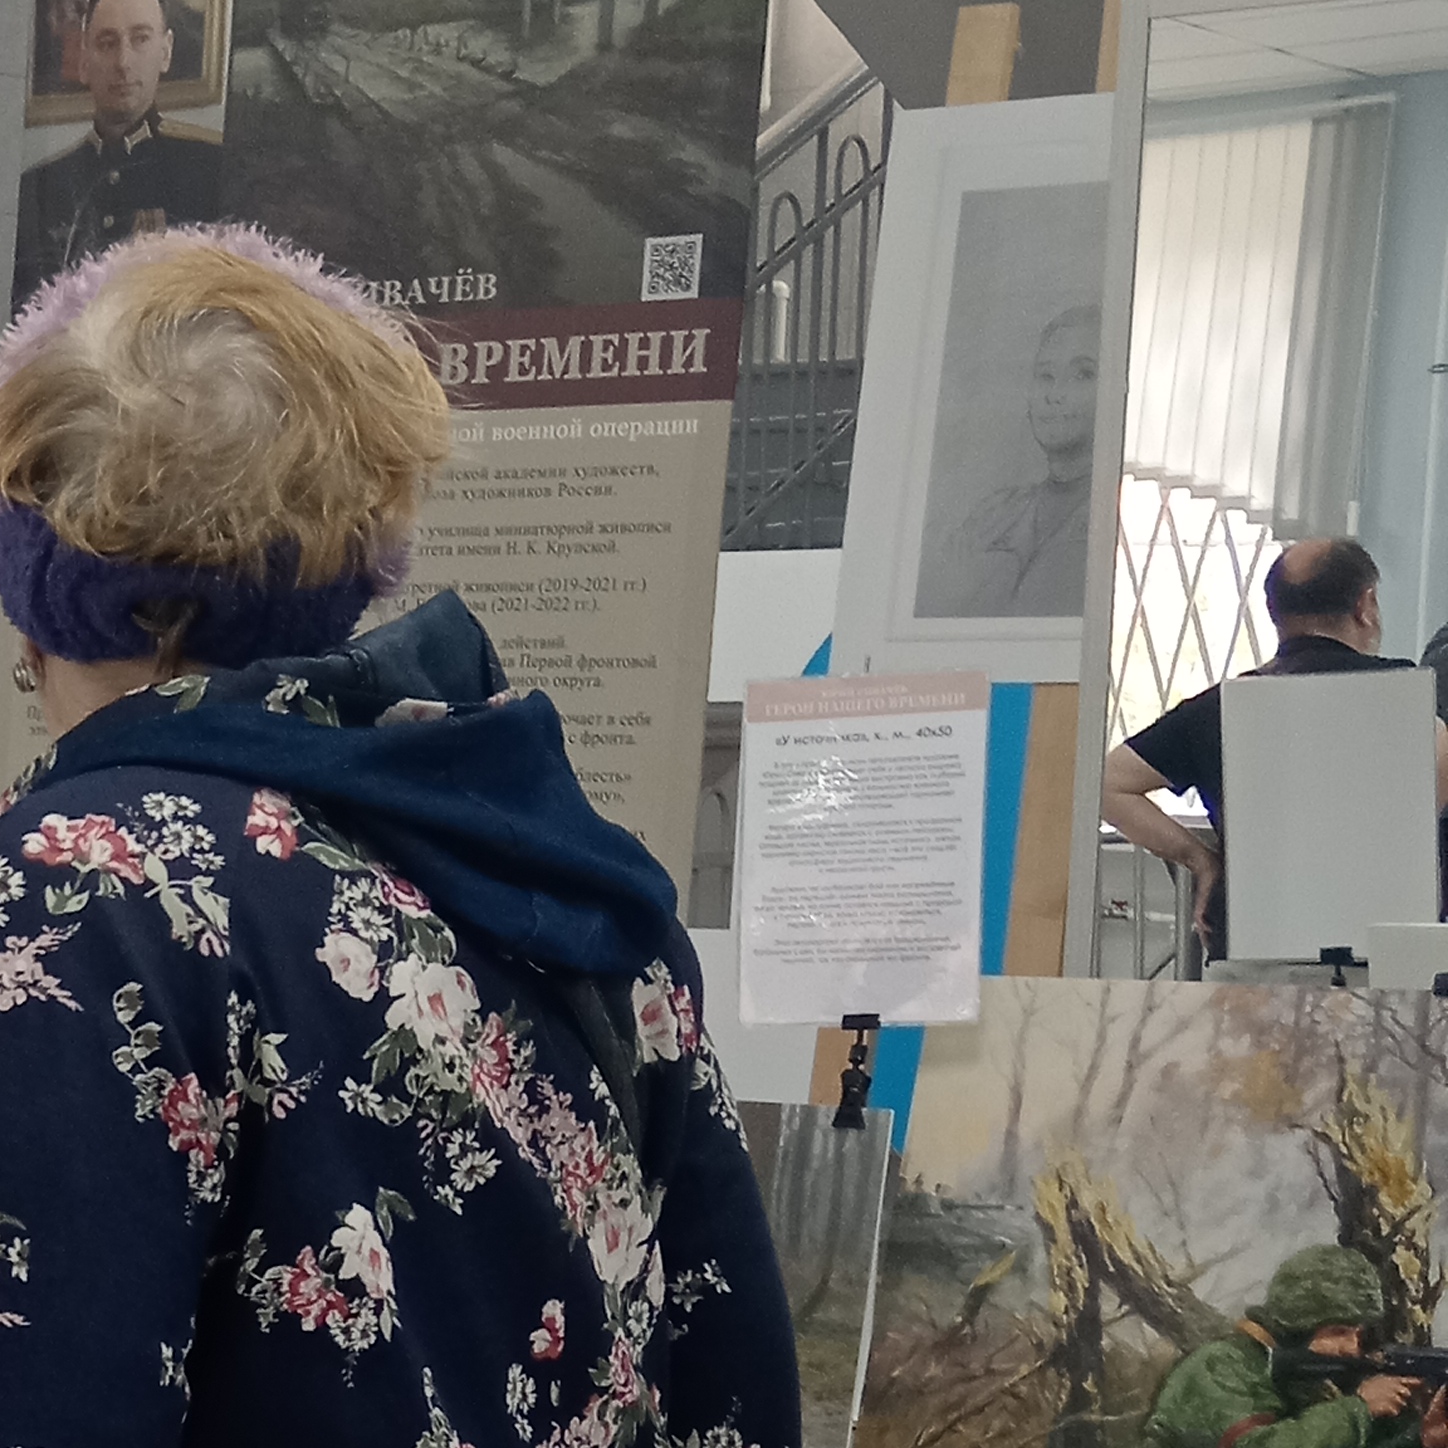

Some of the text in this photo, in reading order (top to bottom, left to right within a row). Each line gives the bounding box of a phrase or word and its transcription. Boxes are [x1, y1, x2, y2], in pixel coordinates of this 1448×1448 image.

[361, 267, 498, 306] ИВАЧЁВ
[439, 328, 711, 386] ВРЕМЕНИ
[492, 419, 582, 441] военной
[590, 419, 699, 441] операции
[573, 463, 660, 481] художеств,
[462, 485, 552, 502] художников
[557, 482, 617, 498] России.
[538, 577, 617, 595] (2019-2021
[520, 653, 573, 672] Первой
[577, 653, 657, 672] фронтовой
[888, 692, 966, 709] ВРЕМЕНИ
